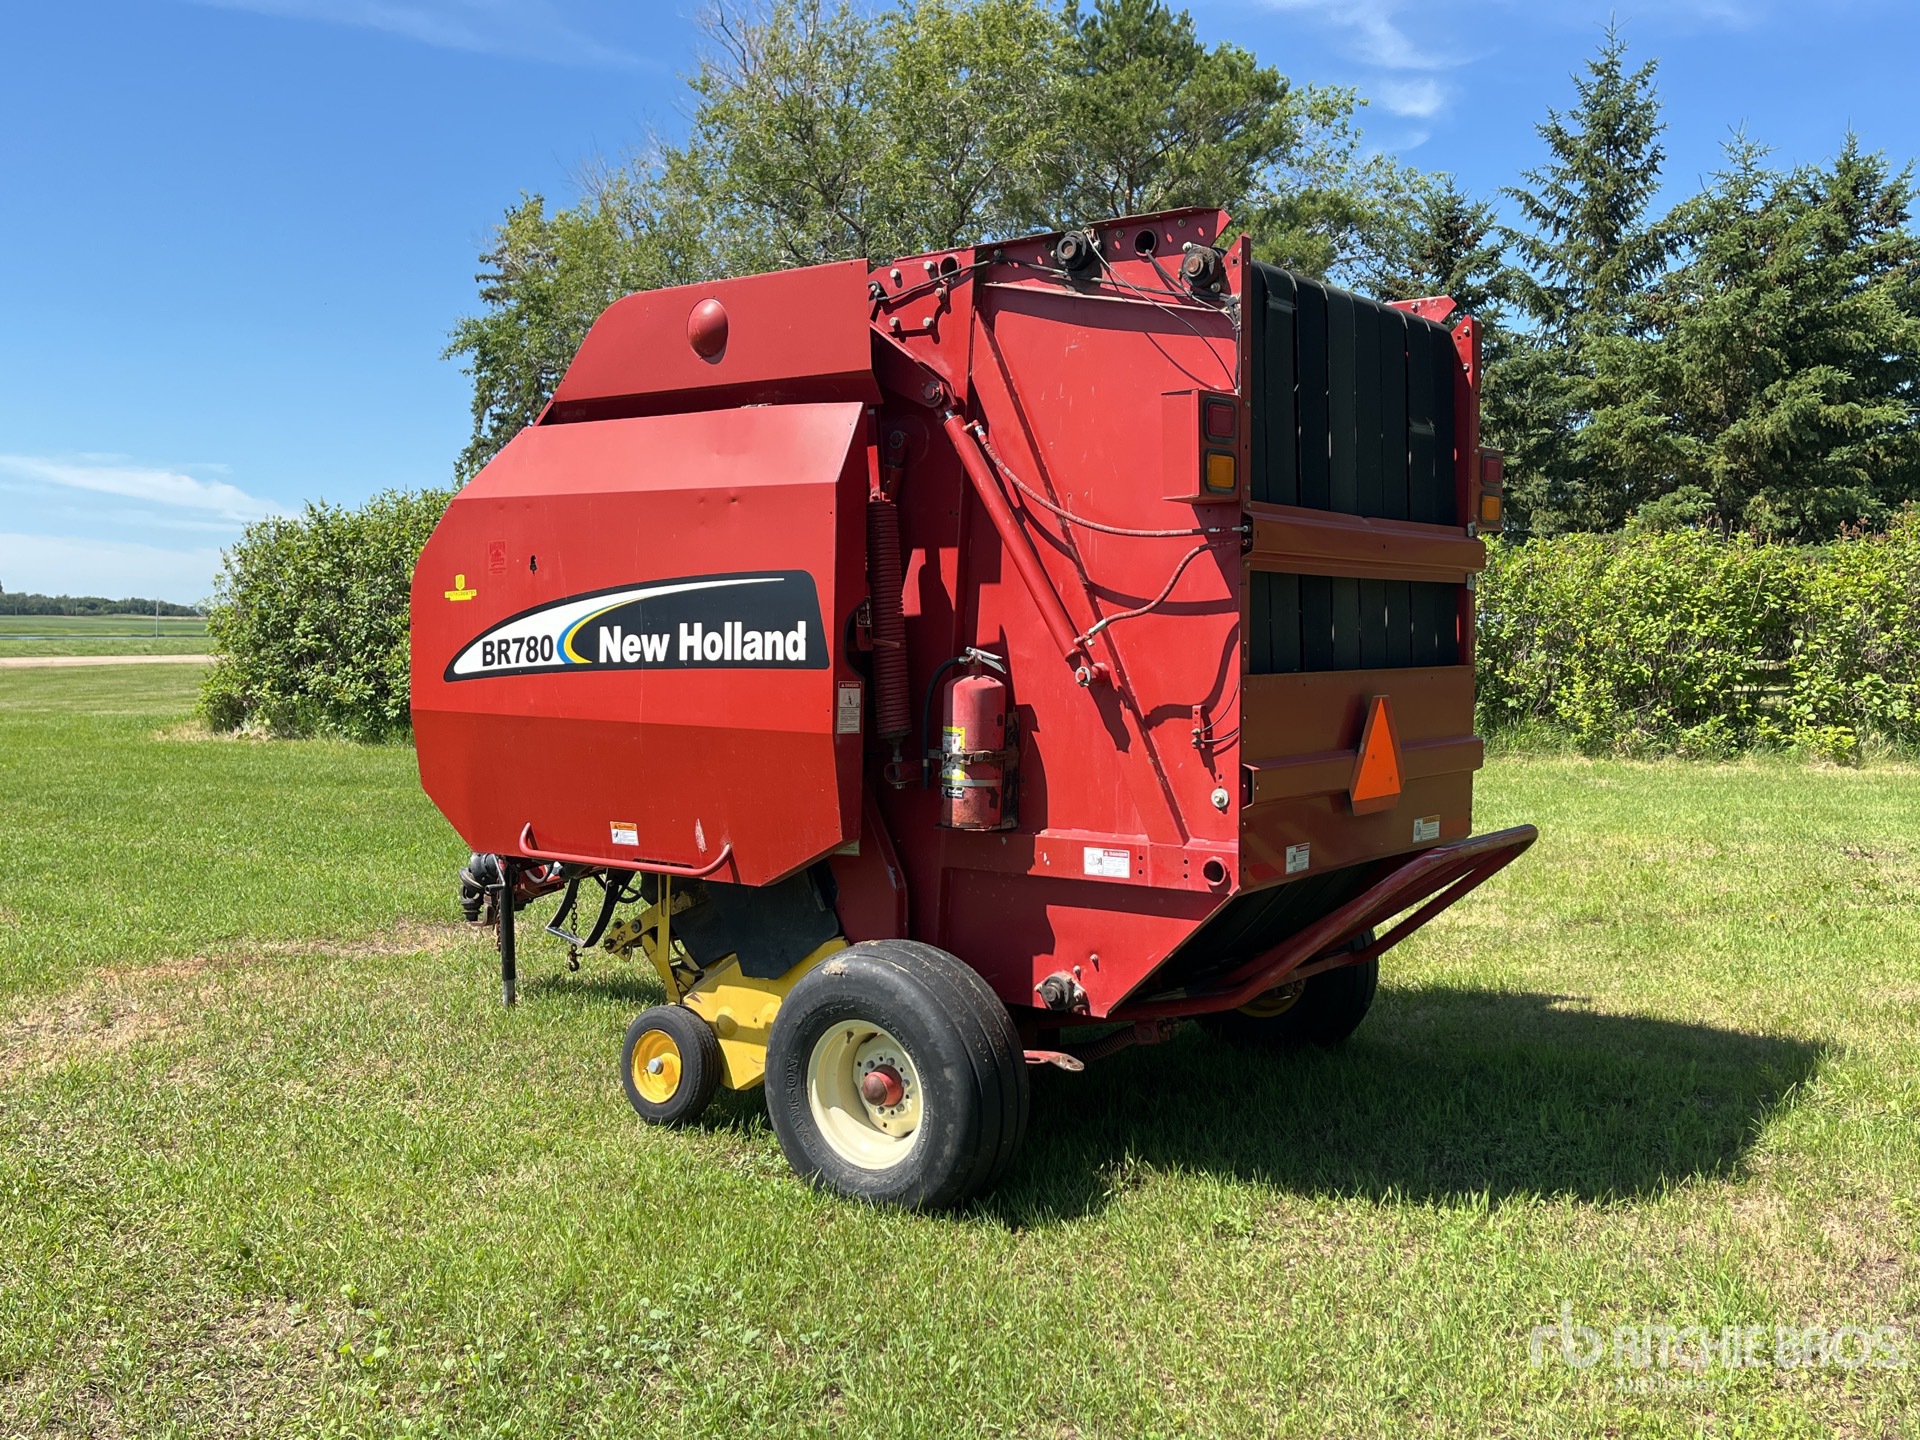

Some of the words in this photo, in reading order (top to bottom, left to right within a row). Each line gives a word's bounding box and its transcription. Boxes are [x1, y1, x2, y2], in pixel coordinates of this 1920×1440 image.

[481, 634, 554, 667] BR780
[599, 625, 671, 663] New
[678, 620, 807, 661] Holland
[786, 1057, 814, 1147] SAMSON
